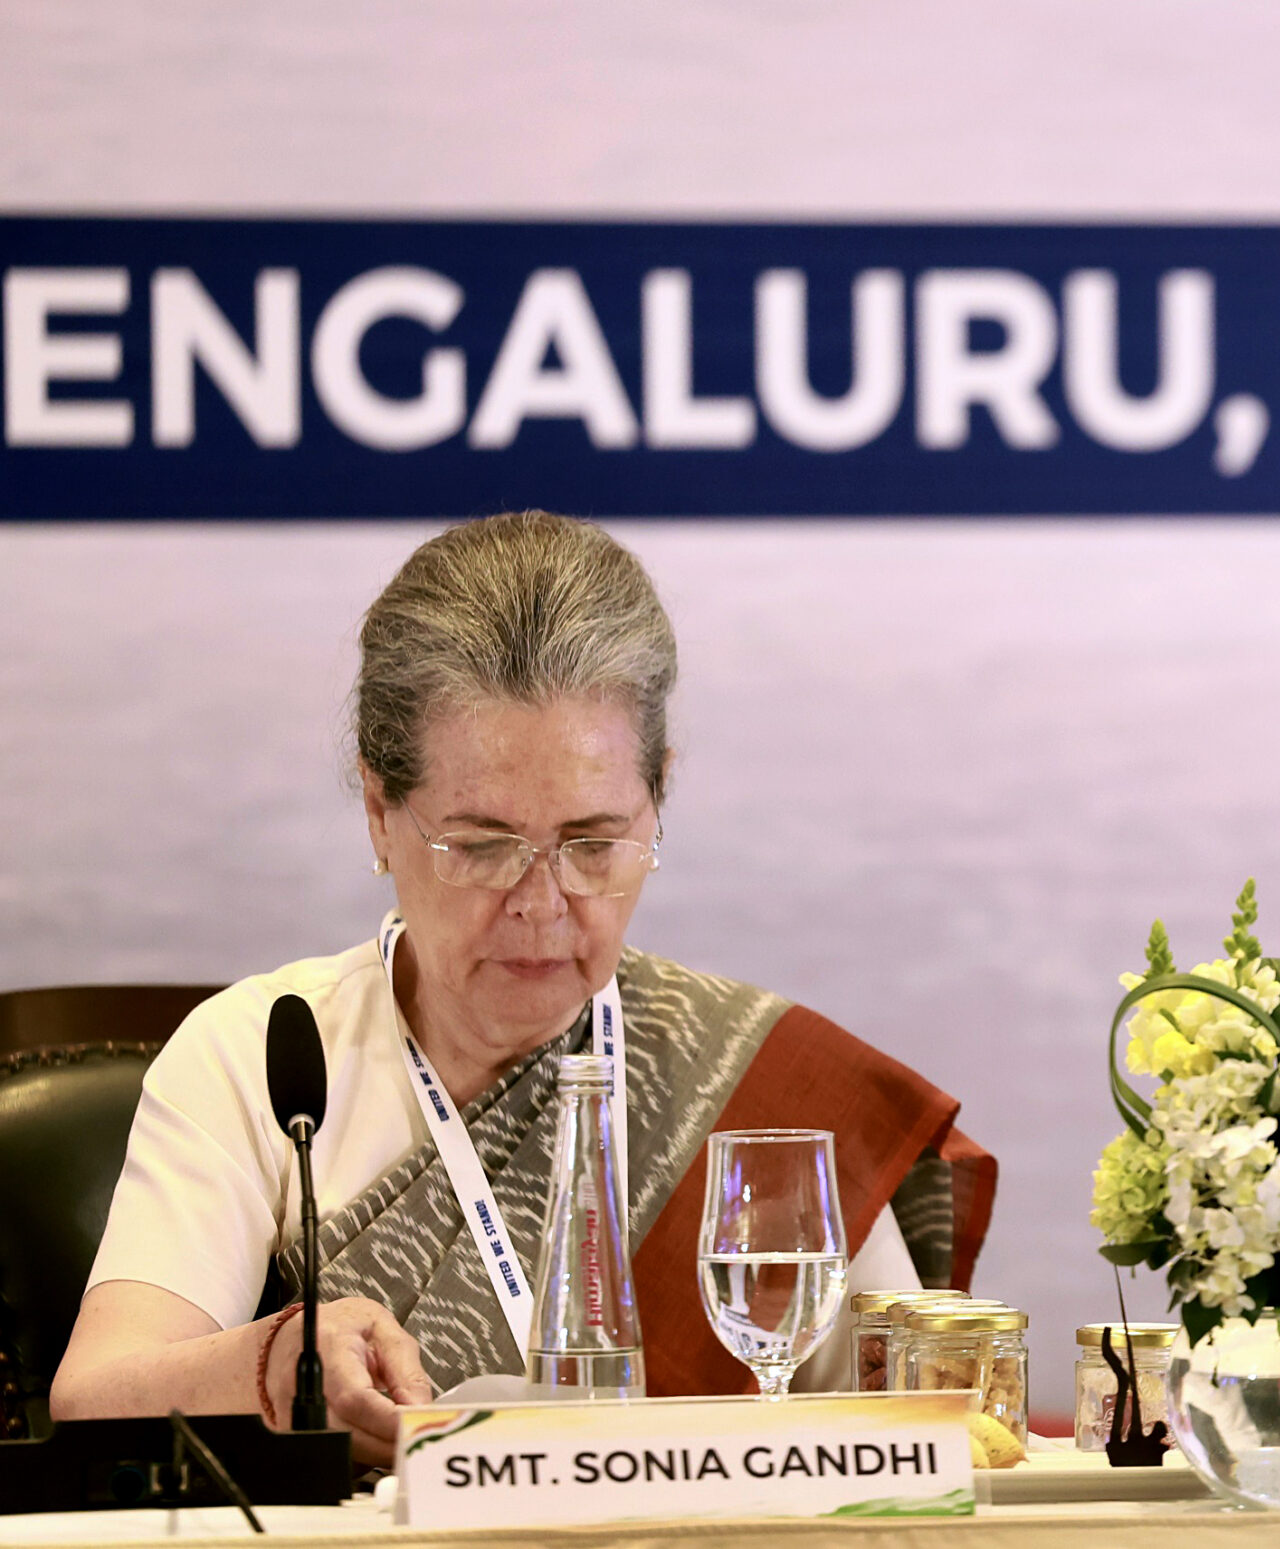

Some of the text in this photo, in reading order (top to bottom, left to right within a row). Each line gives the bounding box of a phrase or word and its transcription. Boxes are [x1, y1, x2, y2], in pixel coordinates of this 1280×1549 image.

[3, 265, 1270, 476] ENGALURU,
[474, 1199, 521, 1297] UNITED WE STAND!
[445, 1441, 940, 1488] SMT. SONIA GANDHI
